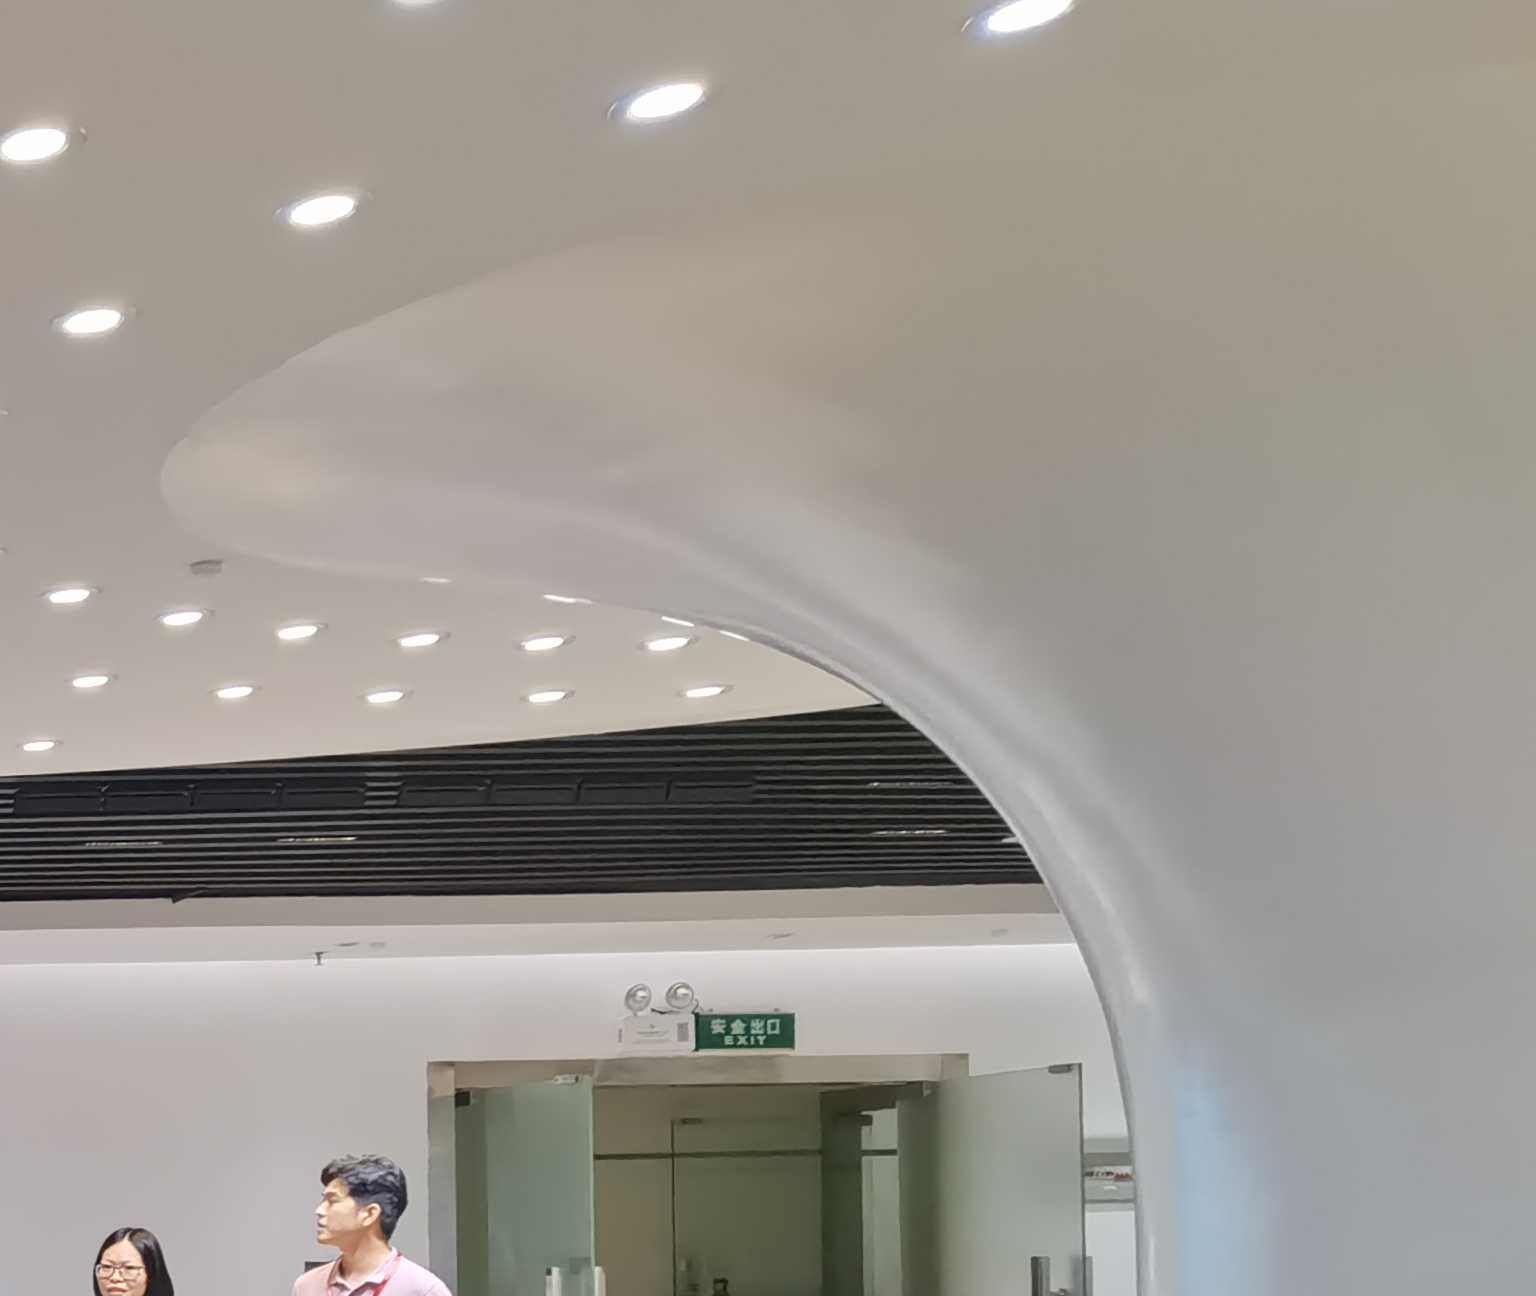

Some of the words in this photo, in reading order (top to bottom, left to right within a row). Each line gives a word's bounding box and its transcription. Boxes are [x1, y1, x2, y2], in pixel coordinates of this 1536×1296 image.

[710, 1018, 782, 1035] 安全出口
[723, 1035, 768, 1046] EXIT
